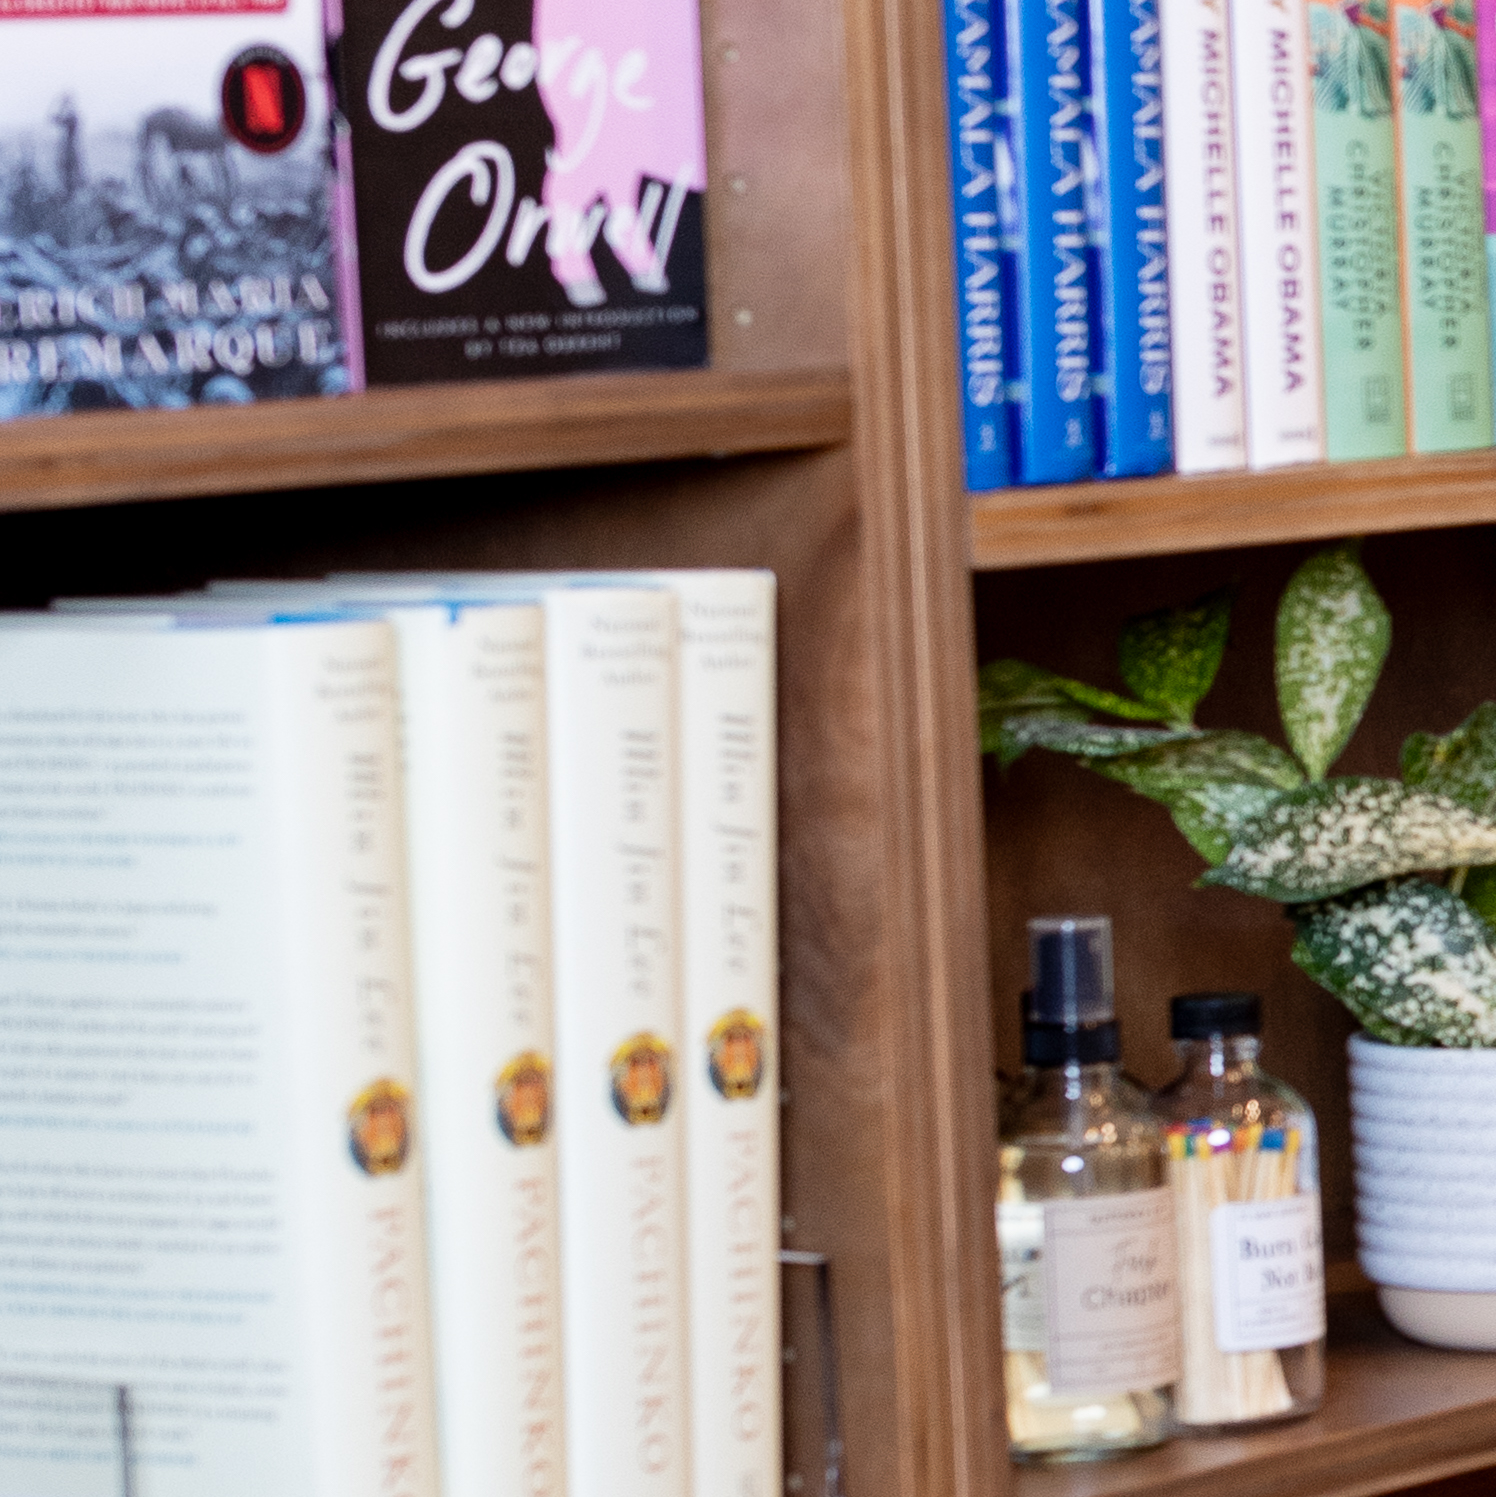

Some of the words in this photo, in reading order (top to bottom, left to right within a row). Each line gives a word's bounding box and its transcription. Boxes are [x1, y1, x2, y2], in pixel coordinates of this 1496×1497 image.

[404, 139, 698, 296] Orwell
[1051, 207, 1092, 406] HARRIS
[723, 1126, 762, 1446] PACHINKO
